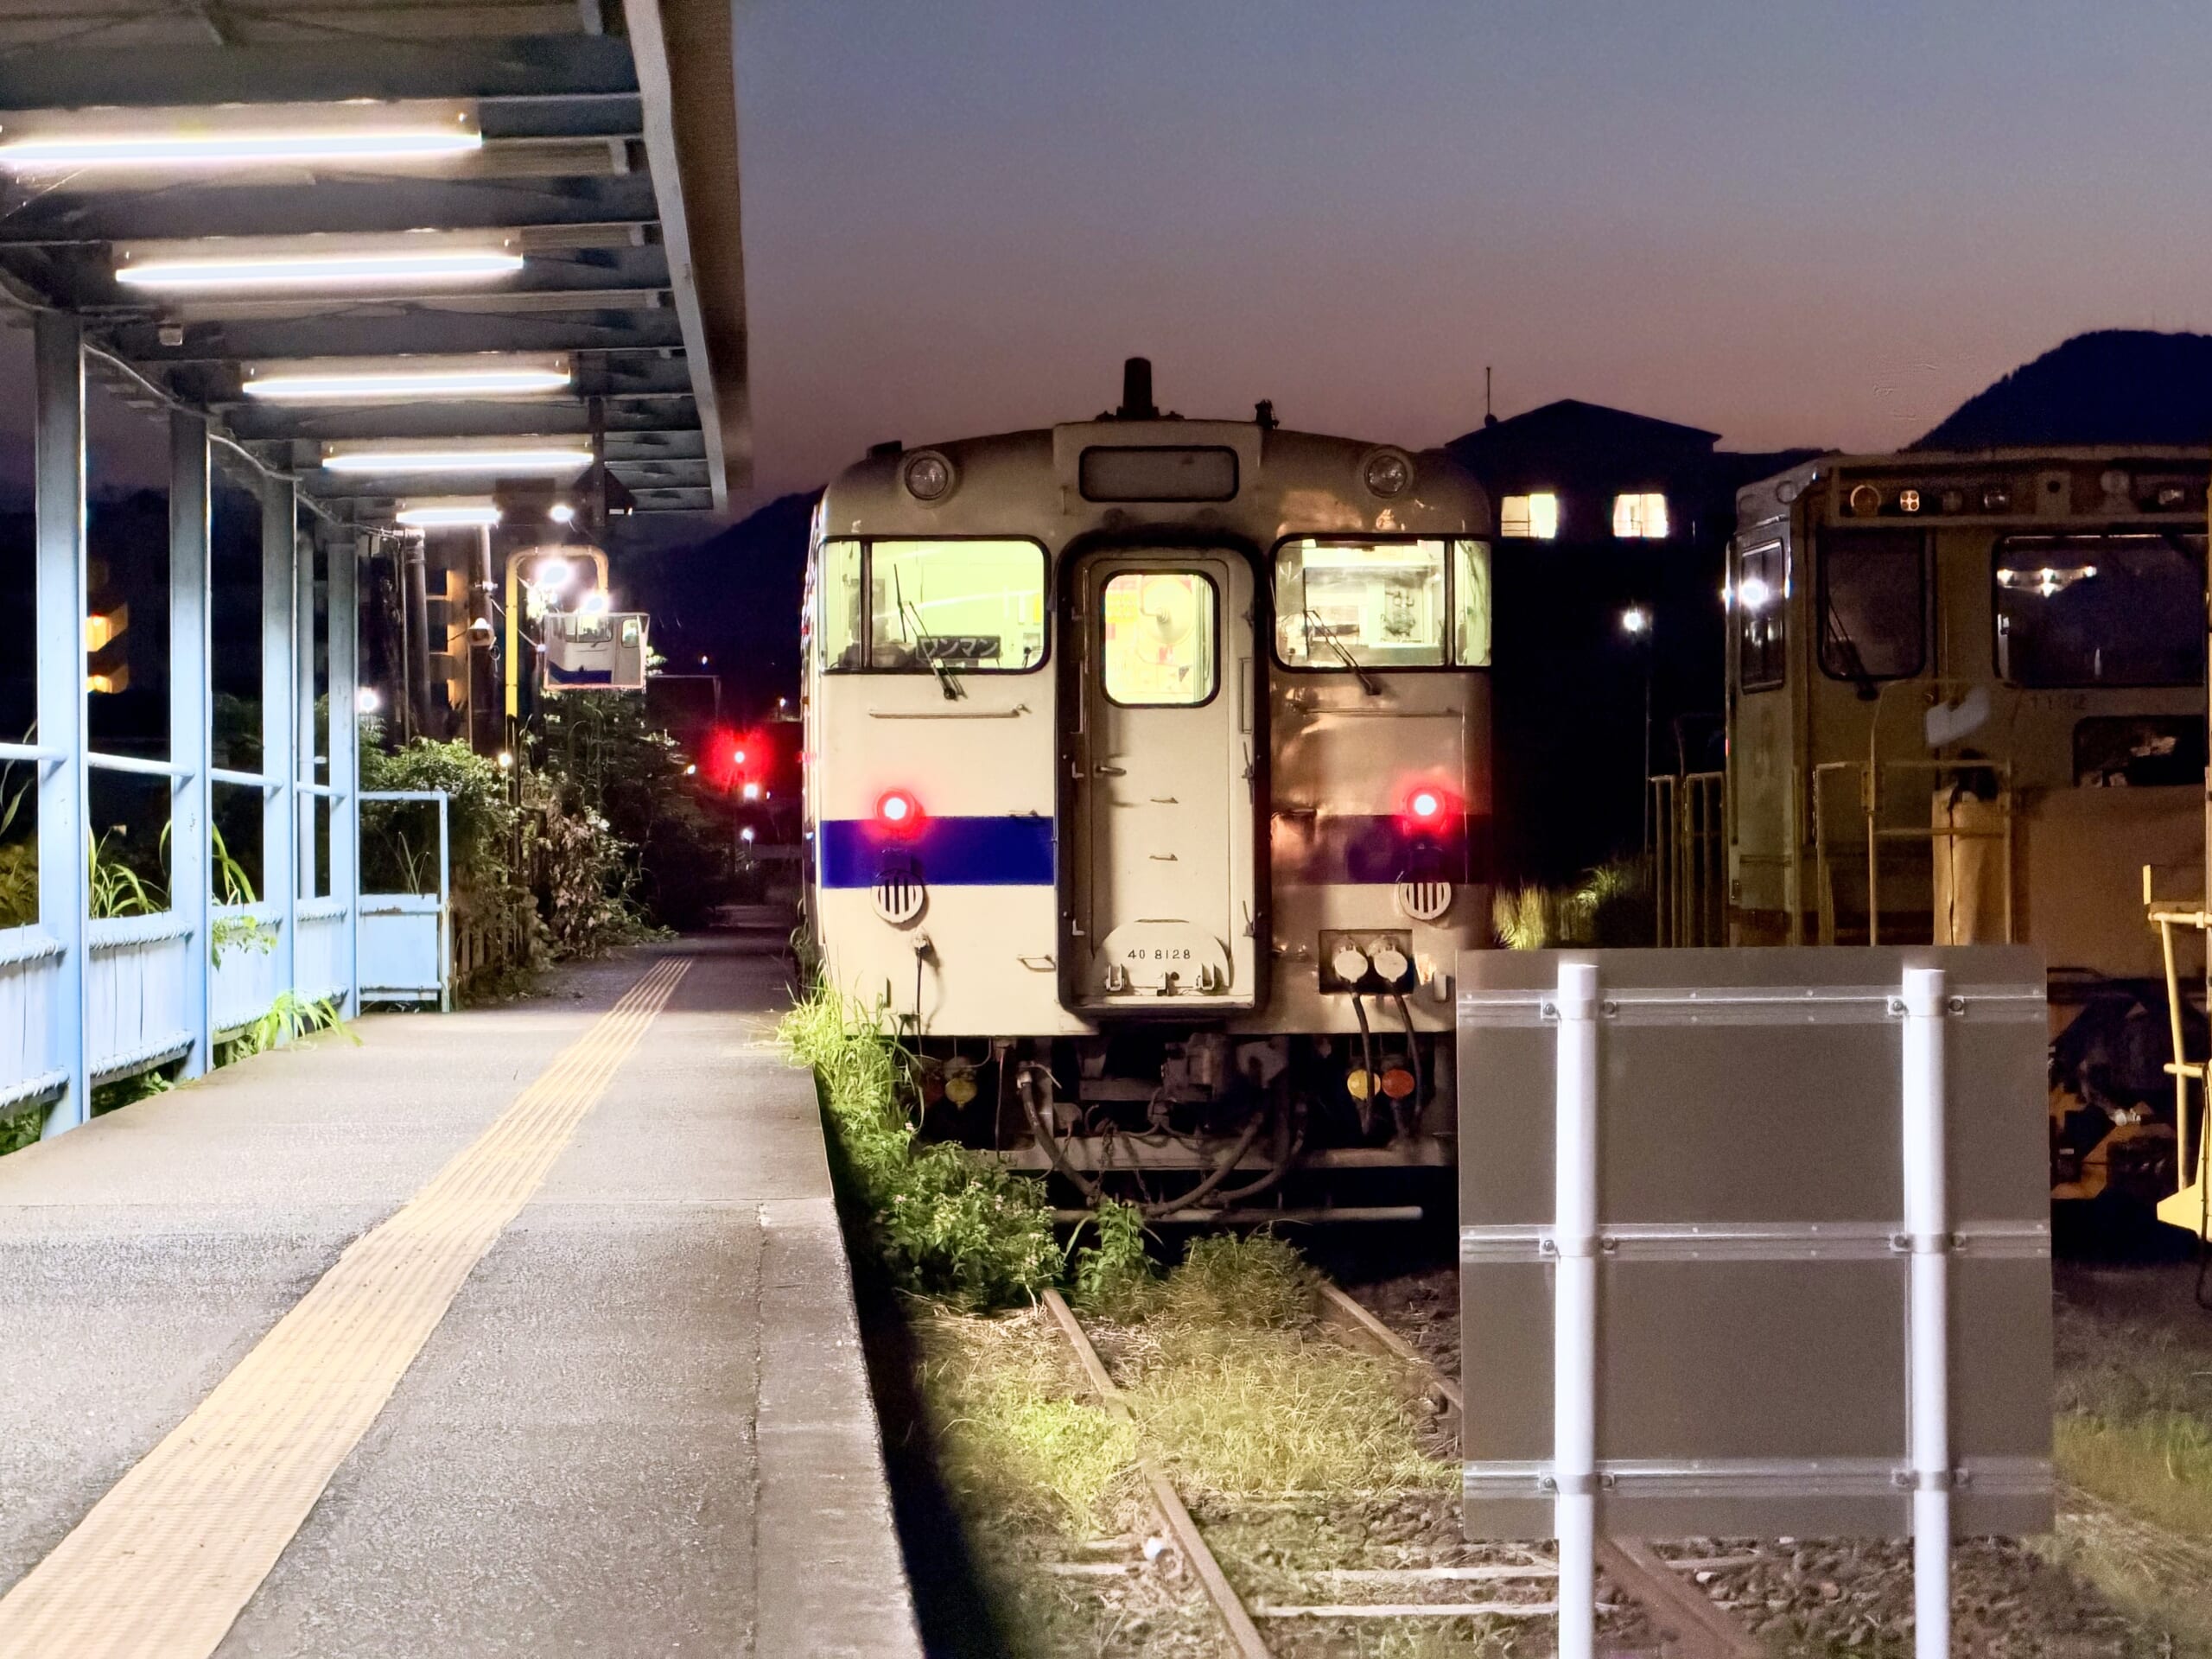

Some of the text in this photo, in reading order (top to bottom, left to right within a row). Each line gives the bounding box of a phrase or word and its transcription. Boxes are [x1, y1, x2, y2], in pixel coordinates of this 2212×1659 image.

[920, 638, 998, 657] ワンマン
[1128, 949, 1191, 960] 40 8128
